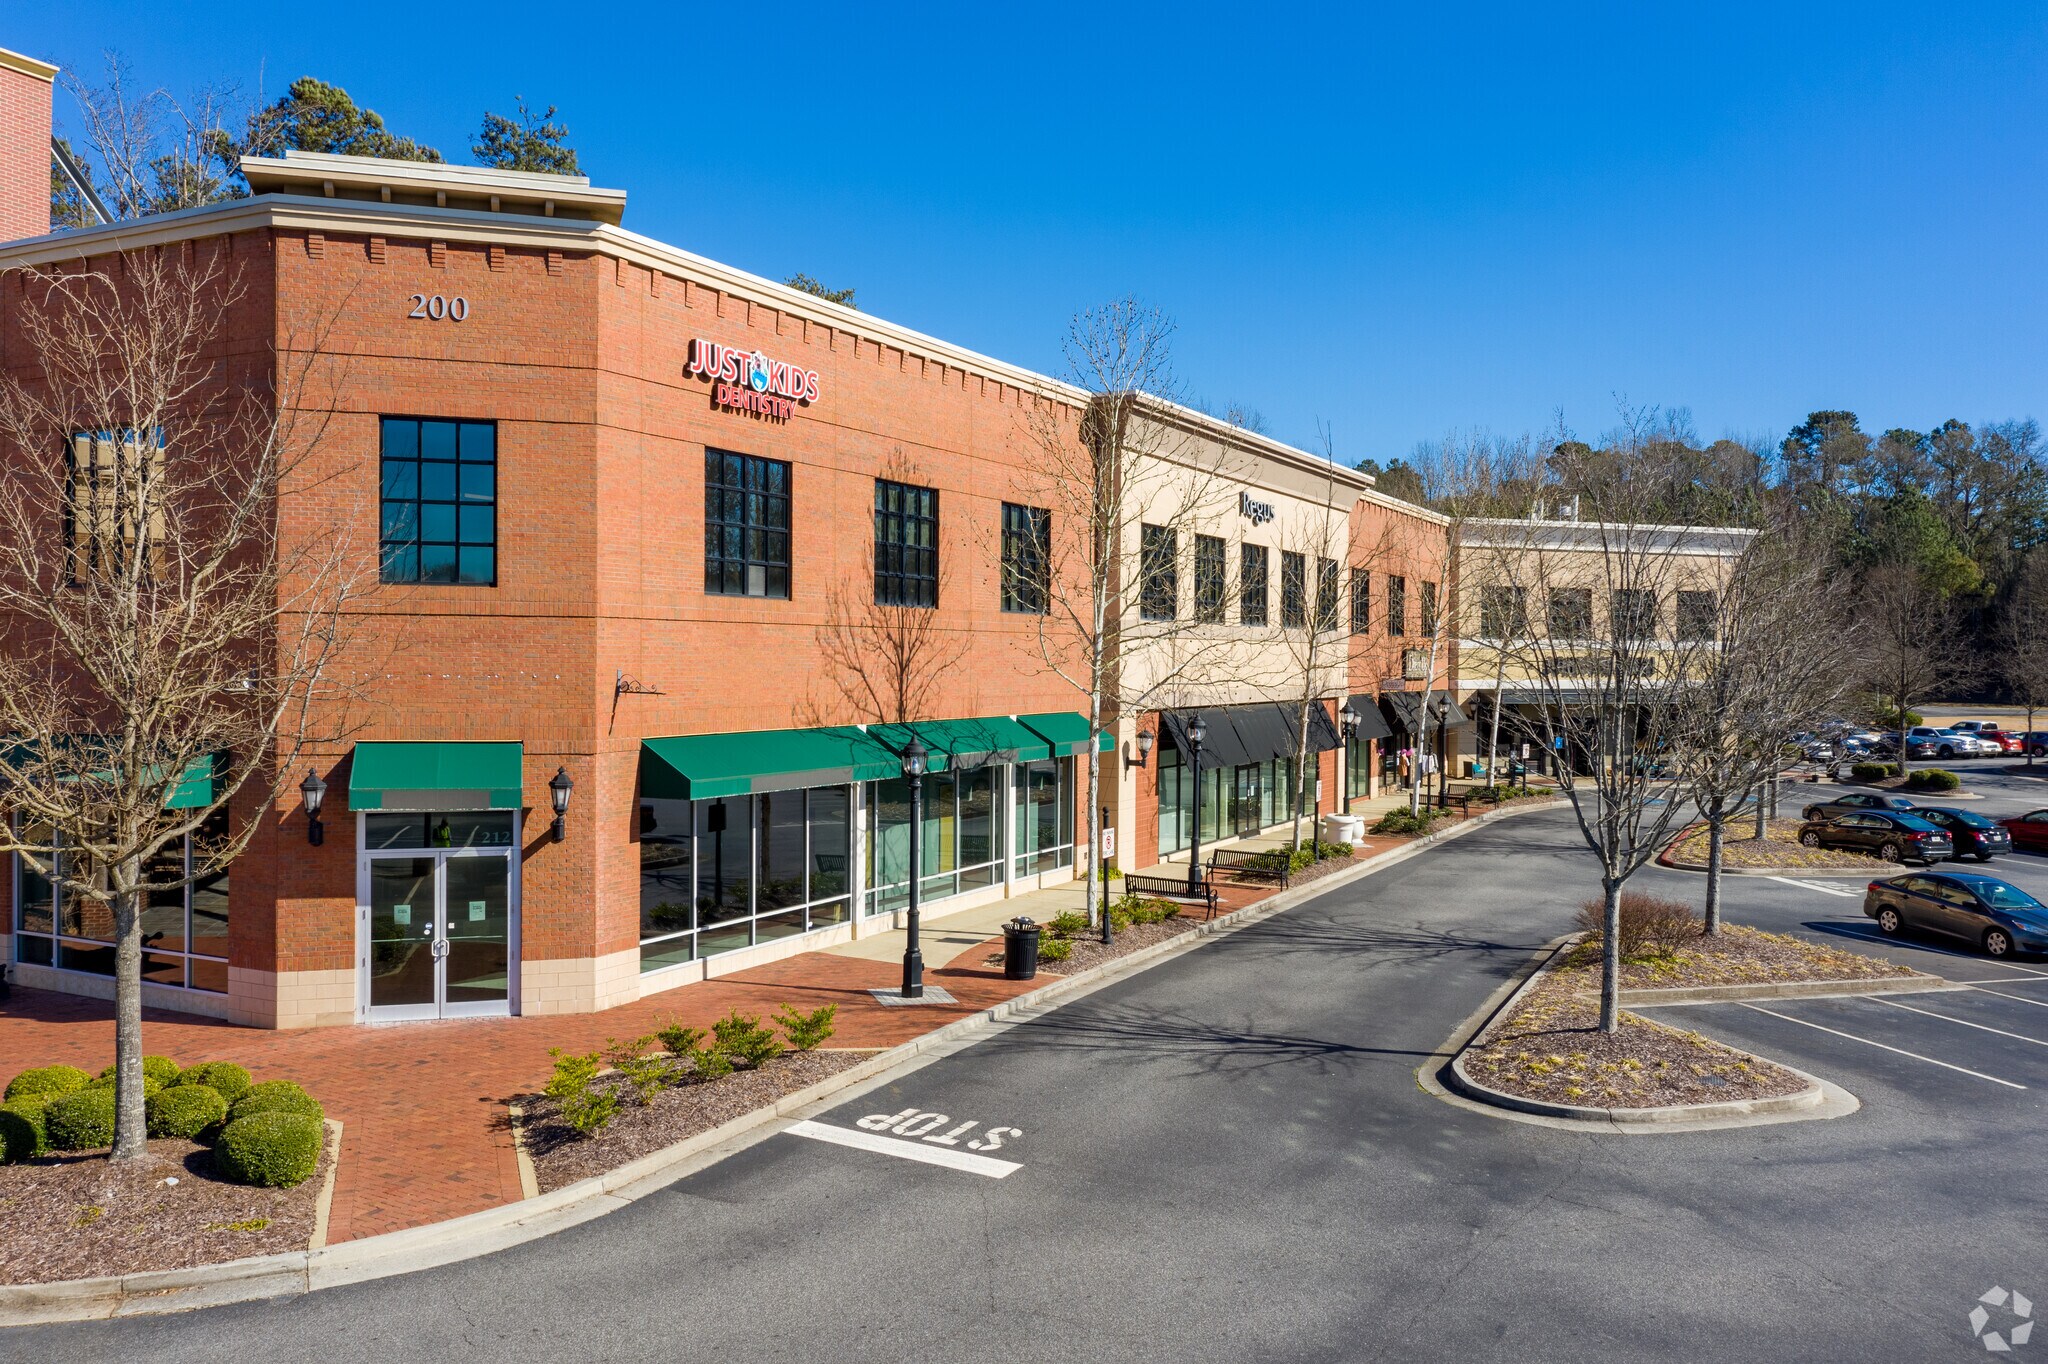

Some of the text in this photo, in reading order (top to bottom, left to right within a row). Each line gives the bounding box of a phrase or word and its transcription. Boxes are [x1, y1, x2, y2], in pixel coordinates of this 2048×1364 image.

[408, 293, 469, 321] 200
[690, 338, 820, 403] JUST KIDS
[717, 382, 796, 420] DENTISTRY
[1243, 492, 1275, 525] Regus
[481, 831, 511, 844] 212
[855, 1107, 1023, 1151] STOP
